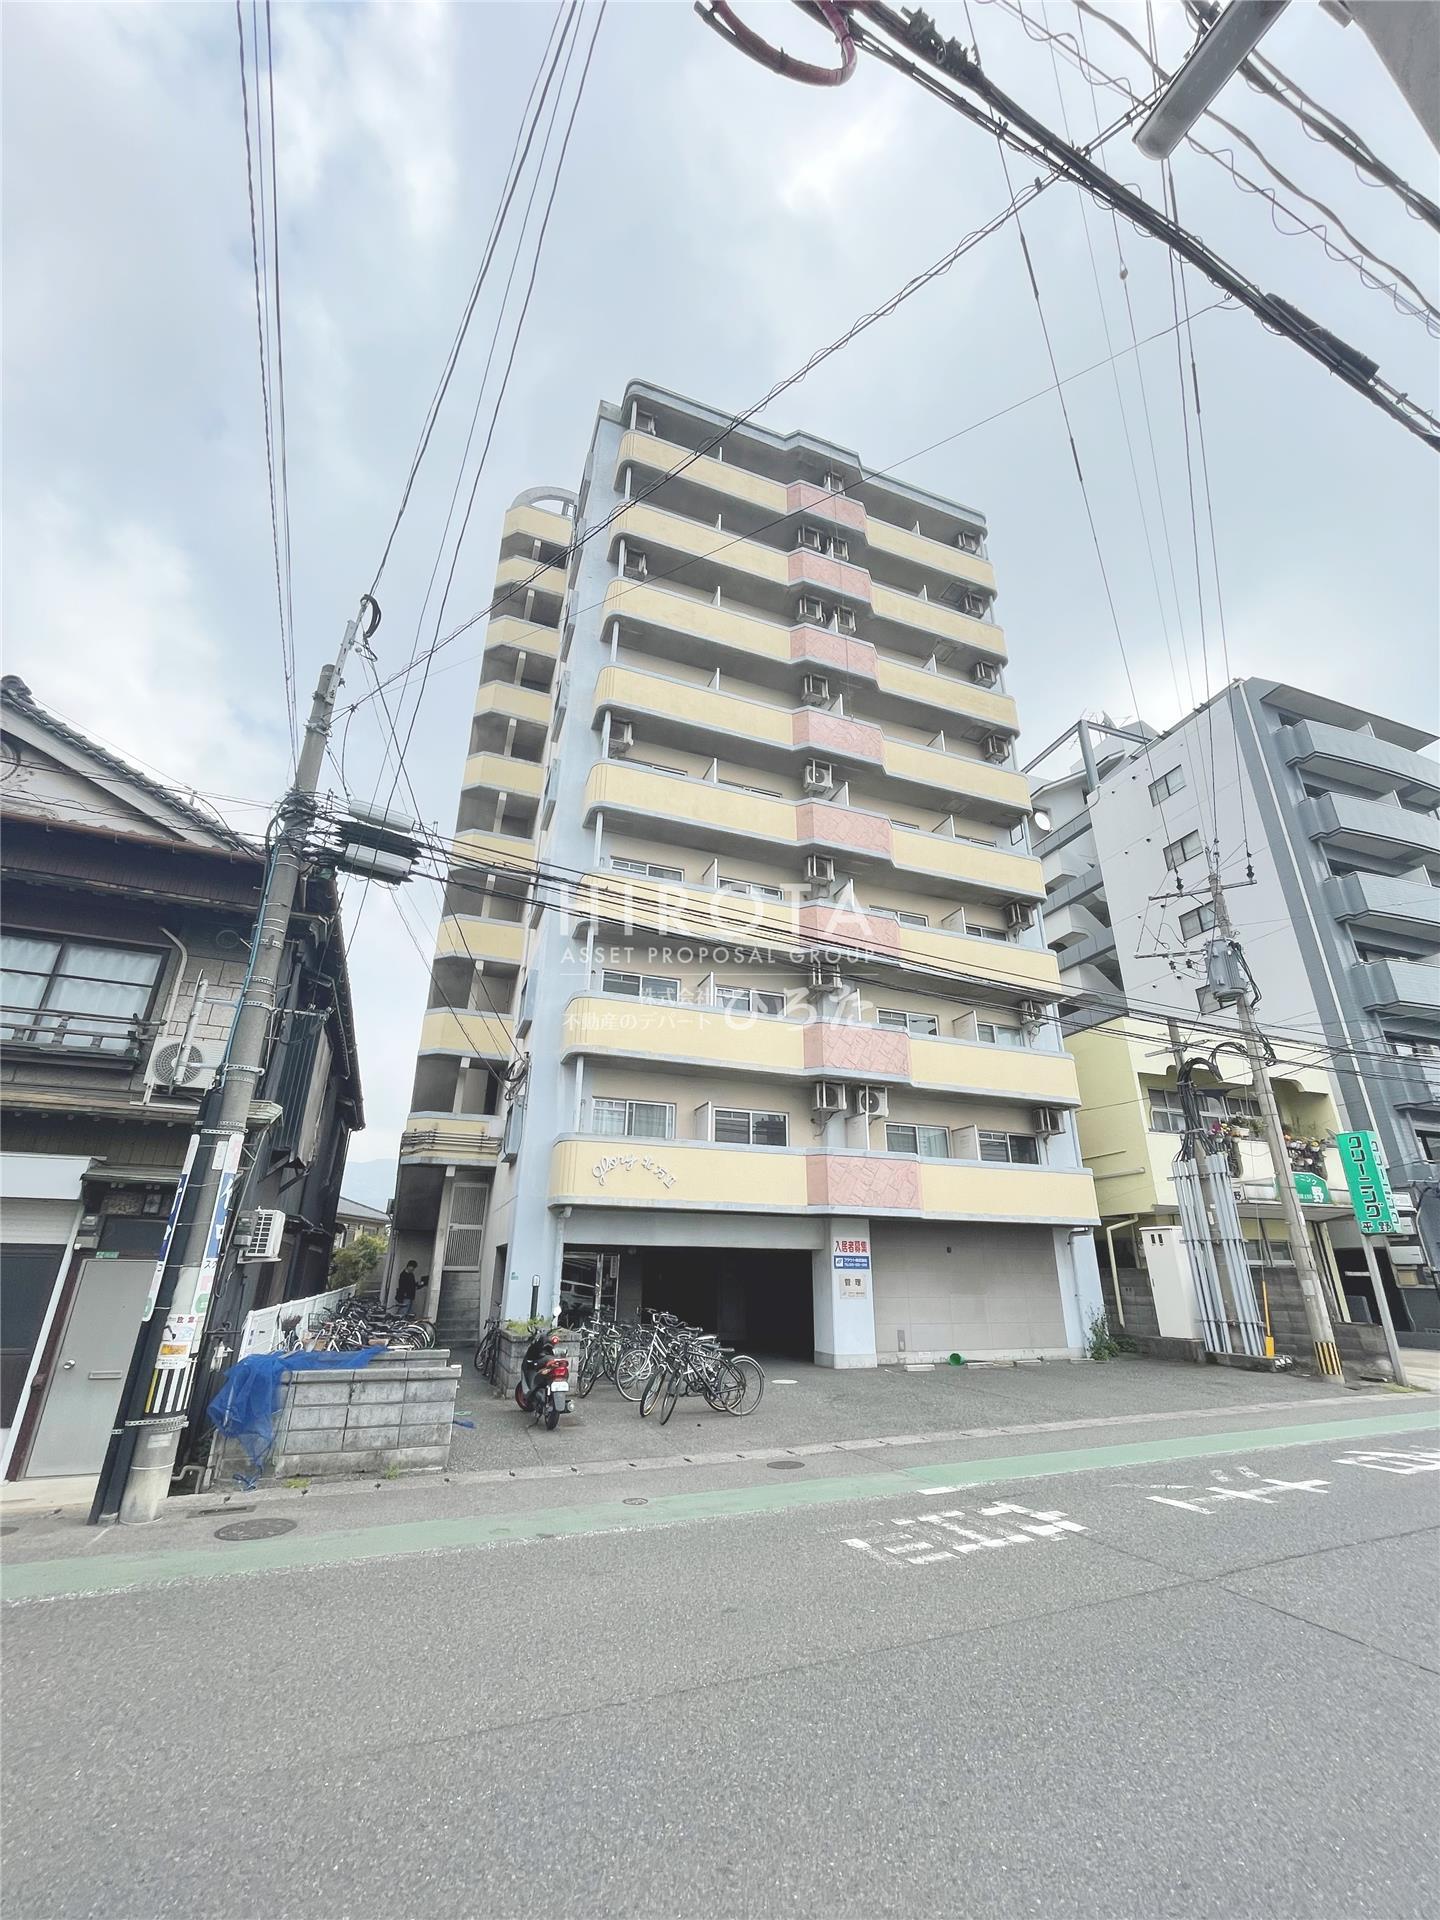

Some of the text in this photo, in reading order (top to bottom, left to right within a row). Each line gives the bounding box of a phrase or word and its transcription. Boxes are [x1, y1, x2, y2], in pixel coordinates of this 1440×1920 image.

[1348, 1135, 1384, 1218] クリーニング
[834, 1240, 868, 1253] 入居者募集
